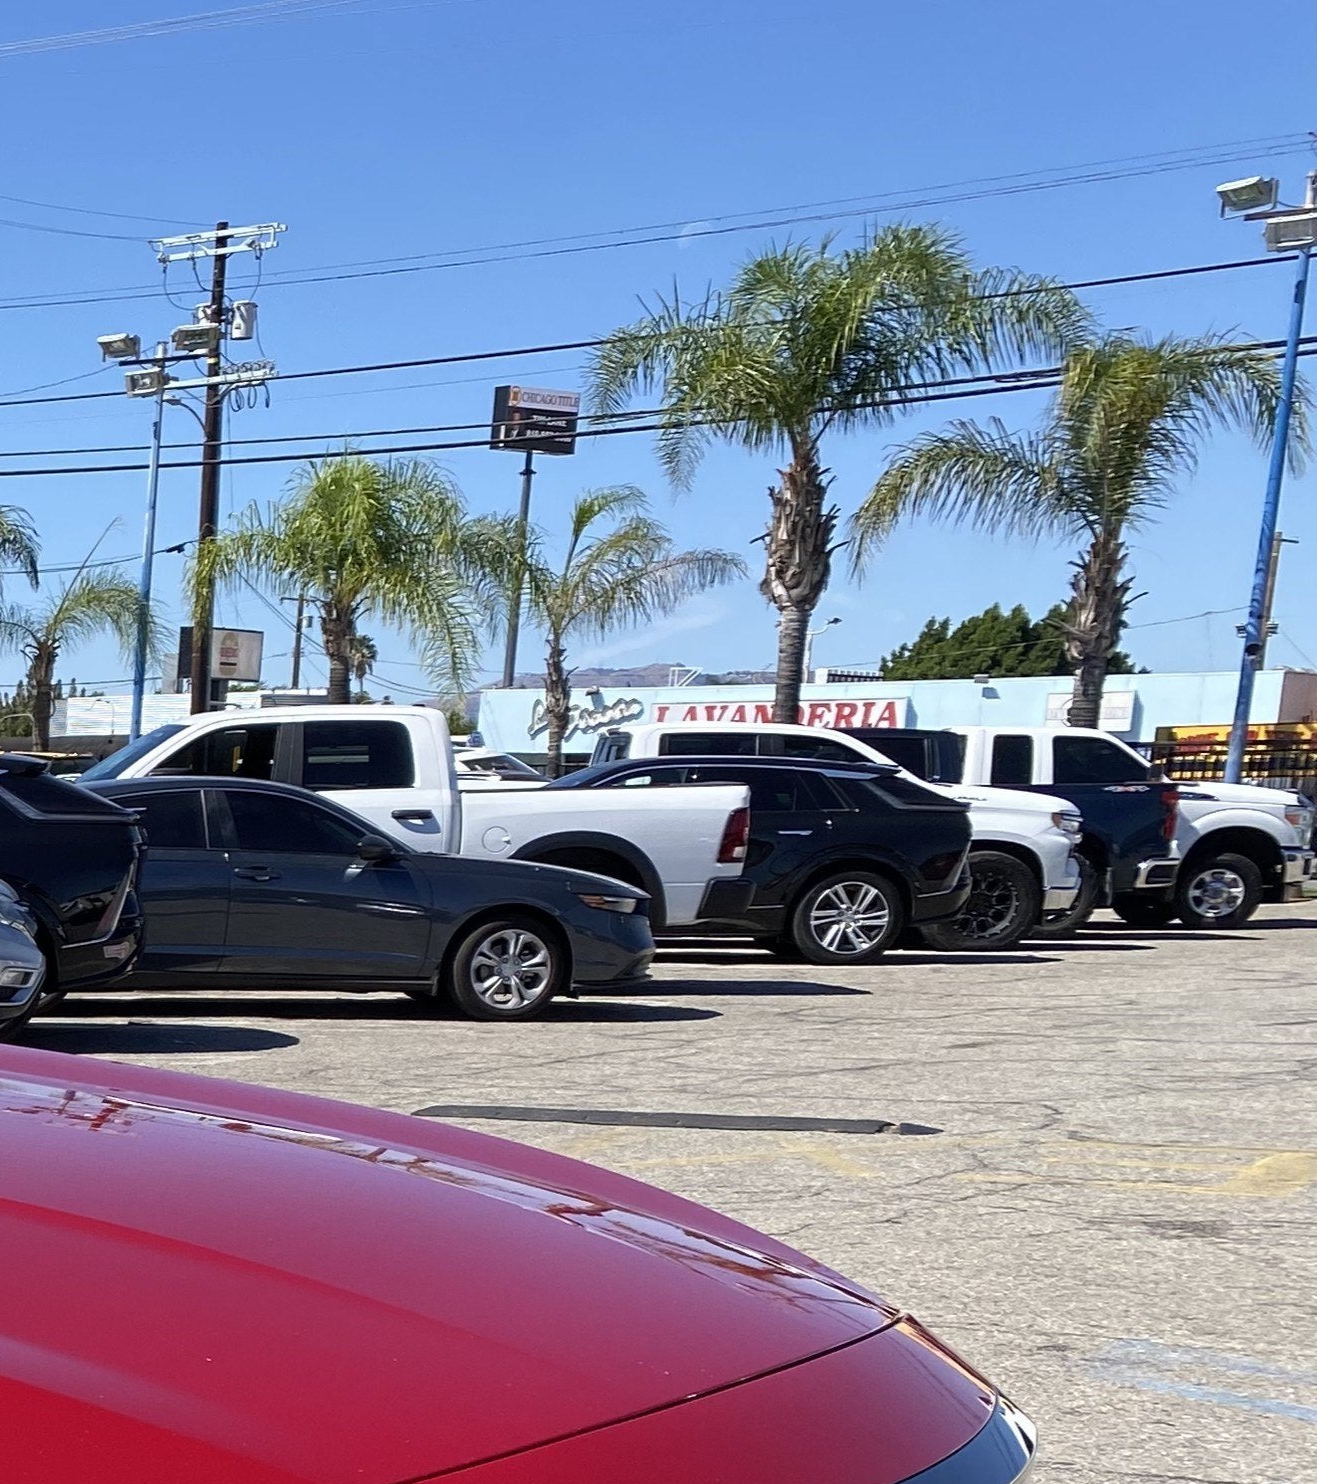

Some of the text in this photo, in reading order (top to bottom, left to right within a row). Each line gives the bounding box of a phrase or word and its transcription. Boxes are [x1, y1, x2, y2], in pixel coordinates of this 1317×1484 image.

[522, 391, 579, 407] CHICAGO TITLE
[655, 701, 898, 729] LAVANERIA
